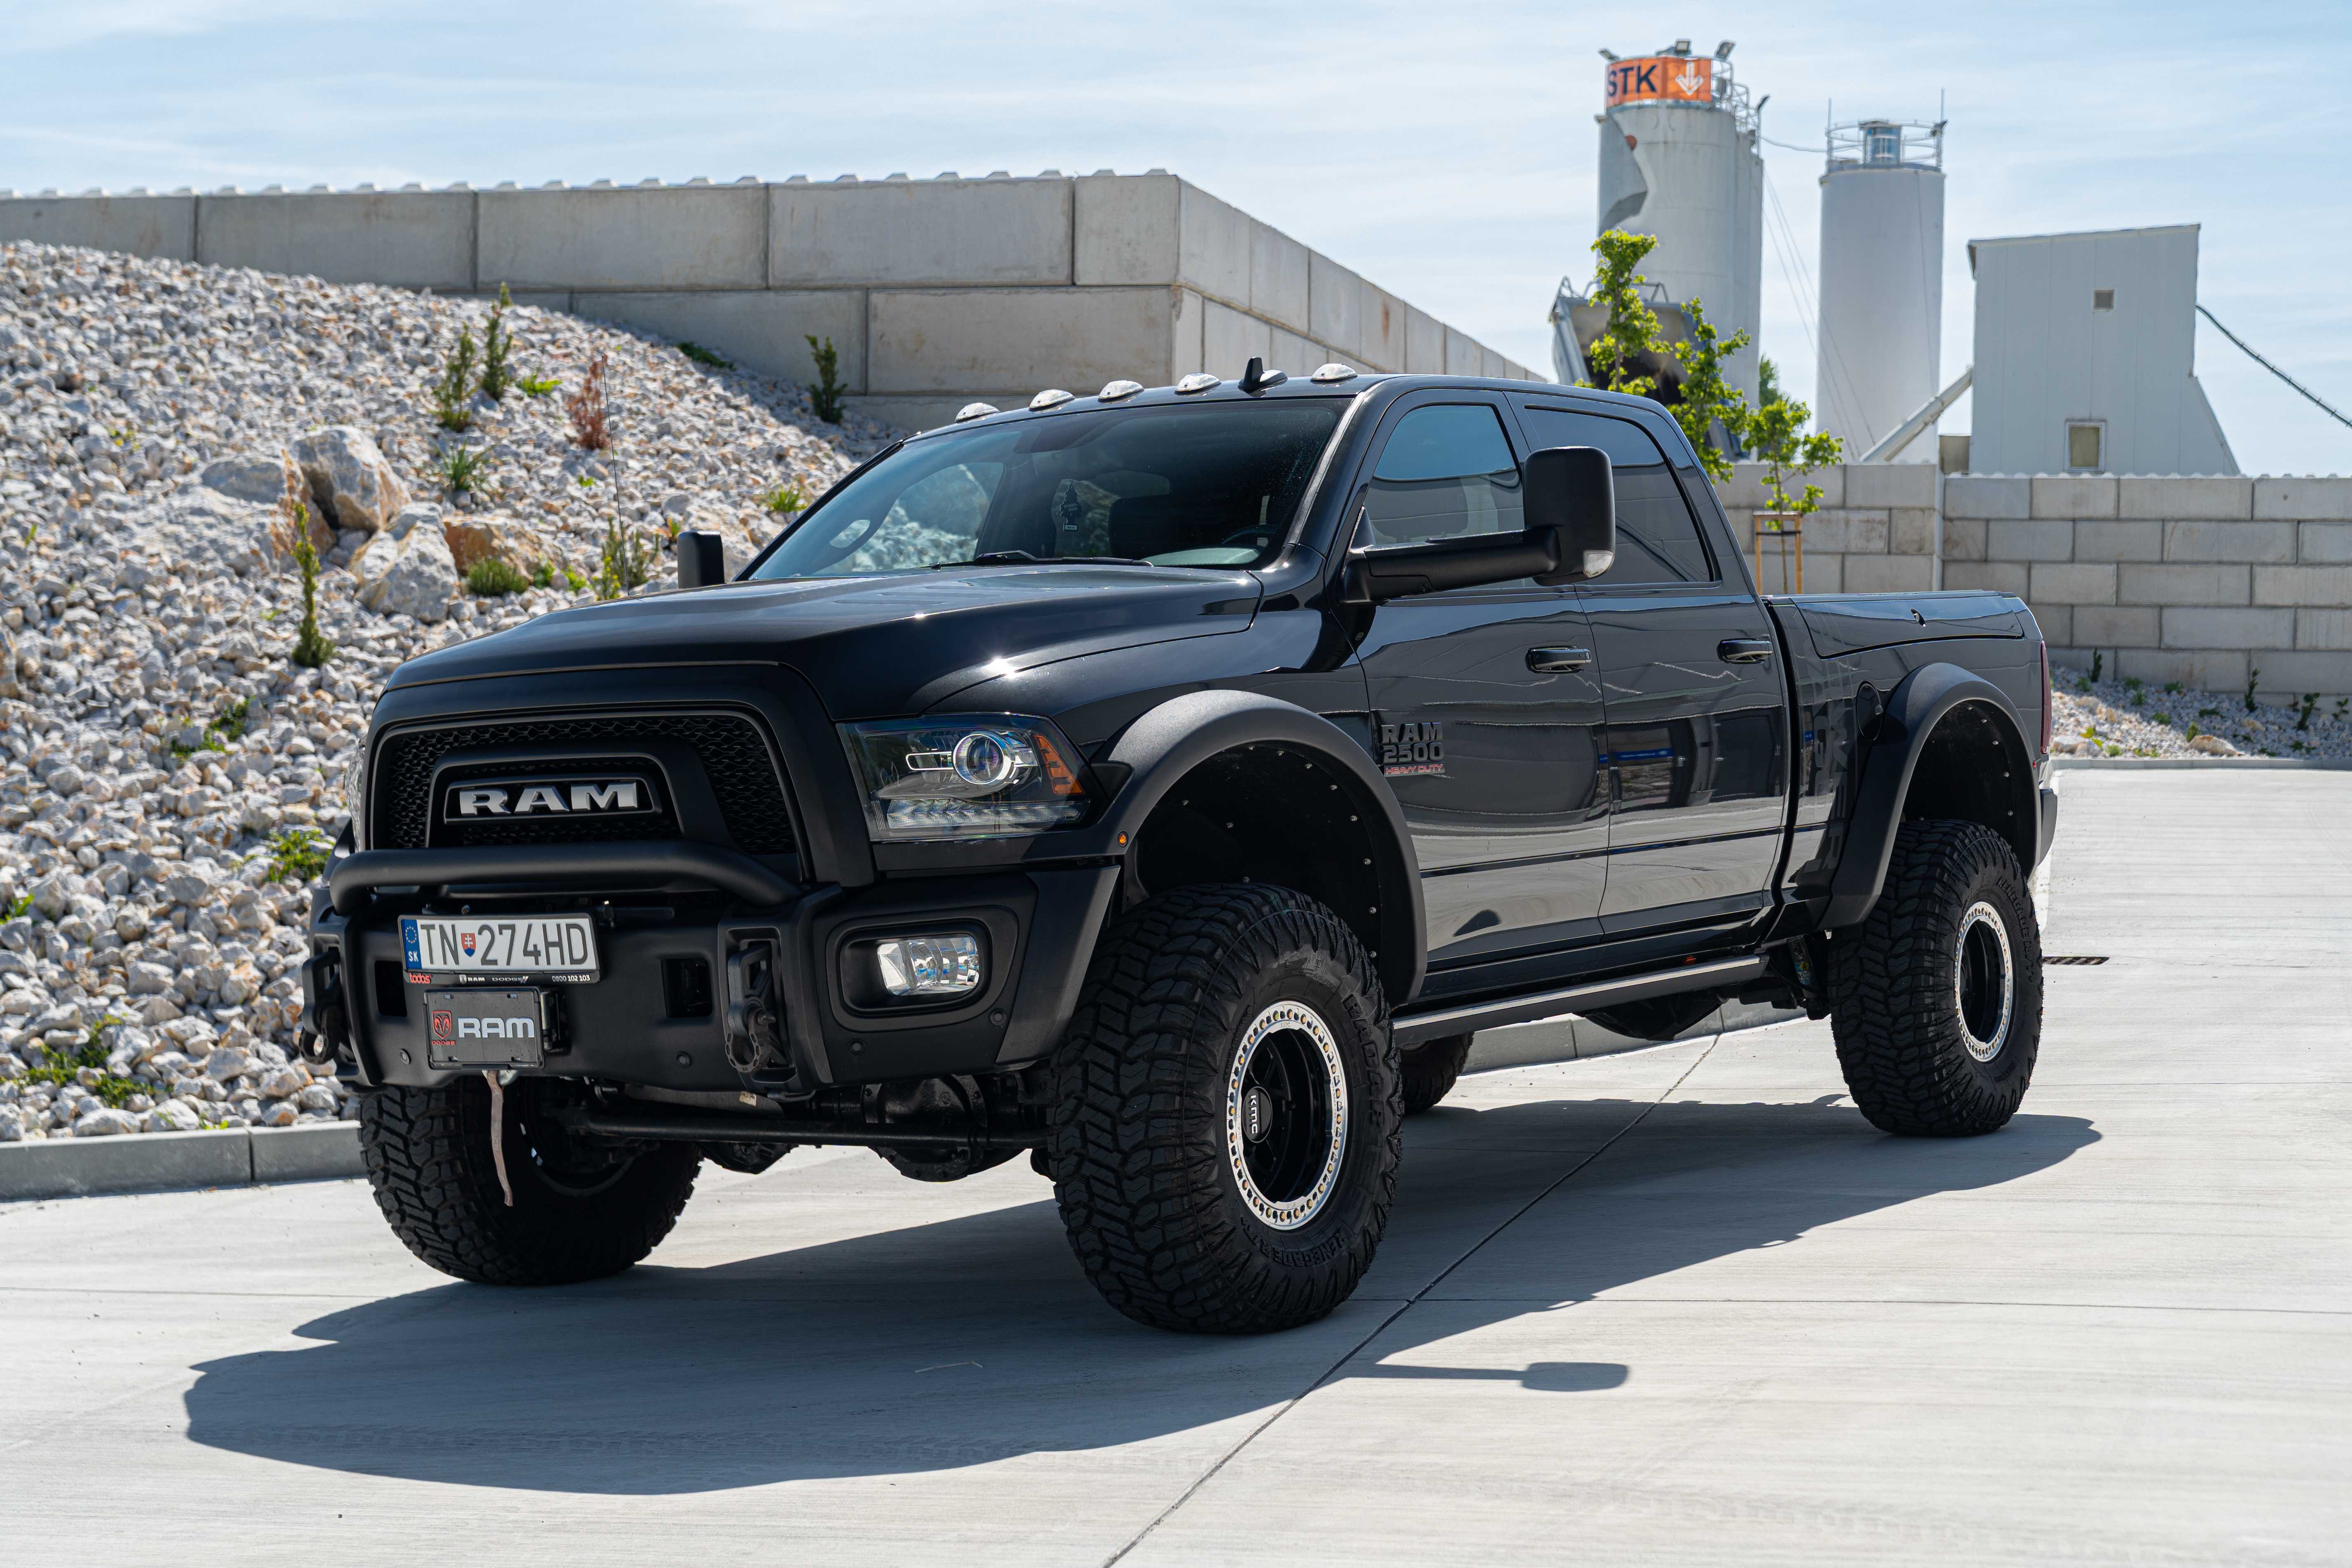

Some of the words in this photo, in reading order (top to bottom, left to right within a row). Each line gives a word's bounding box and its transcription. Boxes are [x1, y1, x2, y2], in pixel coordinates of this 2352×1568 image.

[1608, 64, 1658, 98] STK
[1381, 722, 1443, 743] RAM
[1383, 742, 1444, 763] 2500
[1386, 766, 1417, 775] HEAVY
[1418, 764, 1443, 773] DUTY
[459, 782, 638, 816] RAM
[420, 924, 460, 966] TN
[477, 923, 588, 966] 274HD
[408, 951, 419, 962] SK
[458, 1017, 535, 1038] RAM
